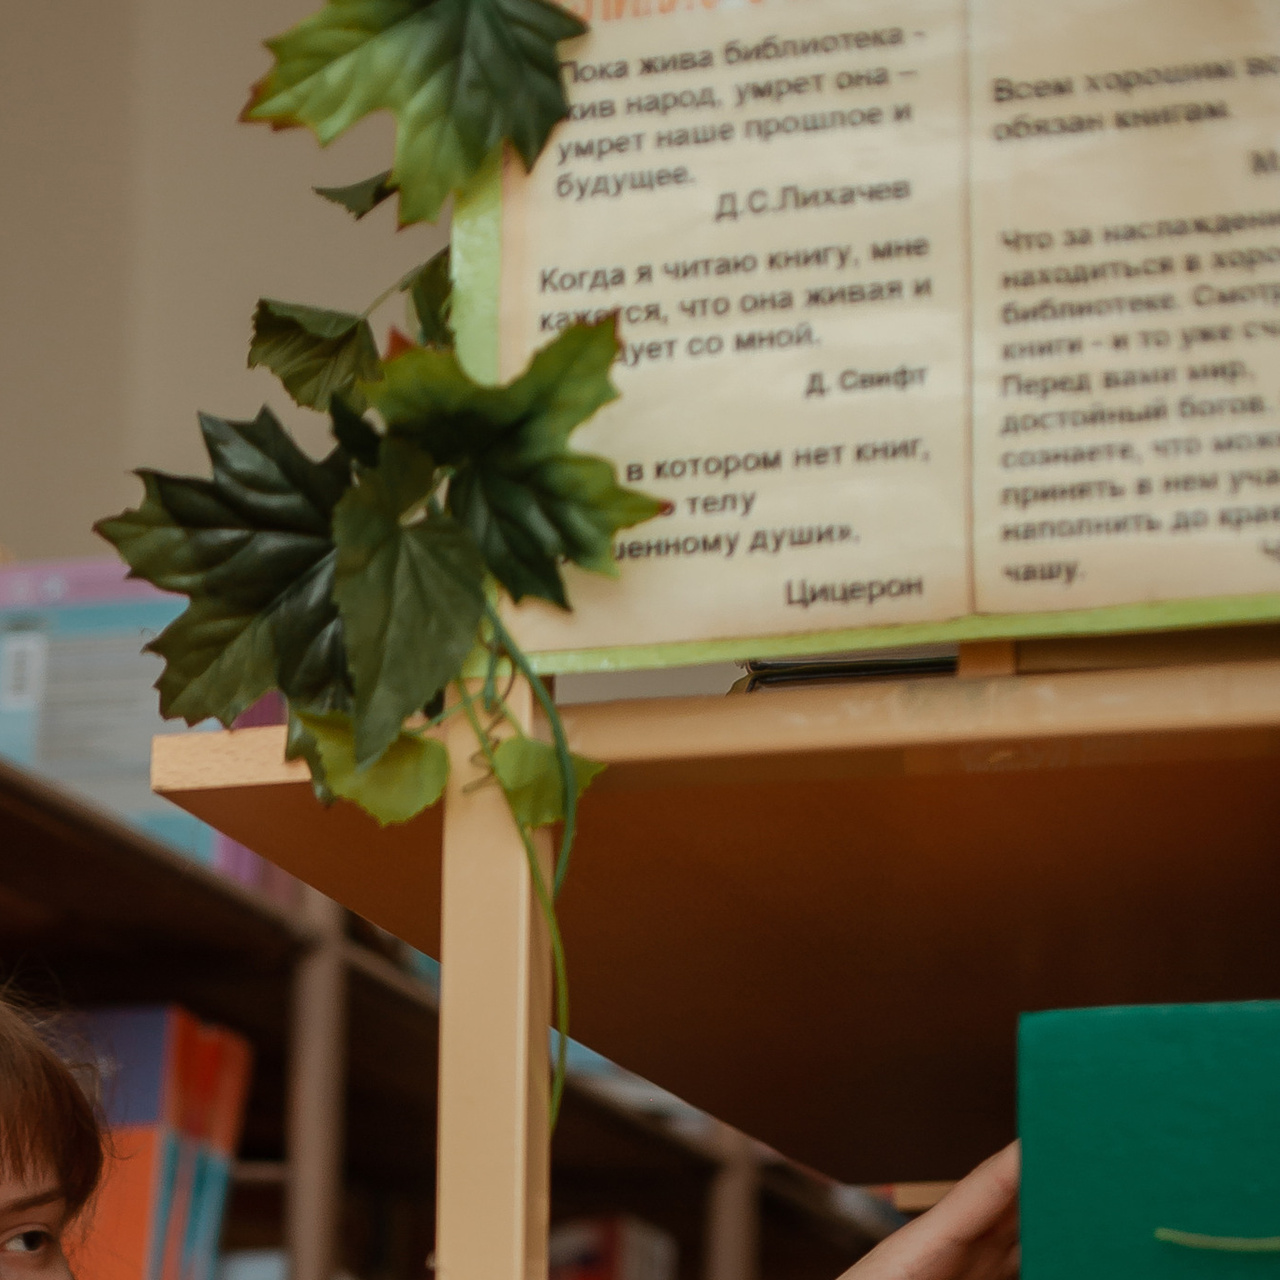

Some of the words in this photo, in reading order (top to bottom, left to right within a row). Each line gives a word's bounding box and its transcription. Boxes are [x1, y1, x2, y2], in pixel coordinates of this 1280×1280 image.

[559, 59, 629, 86] Пока
[639, 48, 714, 76] жива
[723, 26, 903, 67] библиотека
[626, 85, 724, 118] народ,
[733, 72, 825, 107] умрет
[836, 65, 890, 91] она
[993, 77, 1074, 102] Всем
[557, 130, 645, 165] умрет
[656, 117, 735, 149] наше
[744, 104, 883, 142] прошлое
[893, 102, 912, 121] и
[993, 112, 1104, 141] обязан
[556, 164, 696, 200] будущее.
[1002, 229, 1053, 250] Что
[1063, 228, 1092, 246] за
[539, 266, 625, 295] Когда
[635, 263, 653, 282] я
[663, 252, 757, 281] читаю
[767, 242, 860, 272] книгу,
[870, 236, 930, 261] мне
[1003, 256, 1174, 288] находиться
[678, 296, 730, 320] что
[739, 288, 794, 313] она
[803, 280, 903, 307] живая
[914, 278, 932, 298] и
[687, 334, 724, 357] со
[734, 320, 821, 352] мной.
[1139, 329, 1170, 348] то
[839, 364, 928, 393] Свифт
[1002, 373, 1091, 399] Перед
[1001, 401, 1168, 436] достойный
[626, 461, 643, 482] в
[654, 448, 782, 483] котором
[794, 442, 844, 467] нет
[854, 437, 931, 465] книг,
[686, 490, 756, 519] телу
[1002, 479, 1126, 510] принять
[1002, 514, 1162, 542] наполнить
[1172, 509, 1209, 532] до
[785, 576, 924, 609] Цицерон
